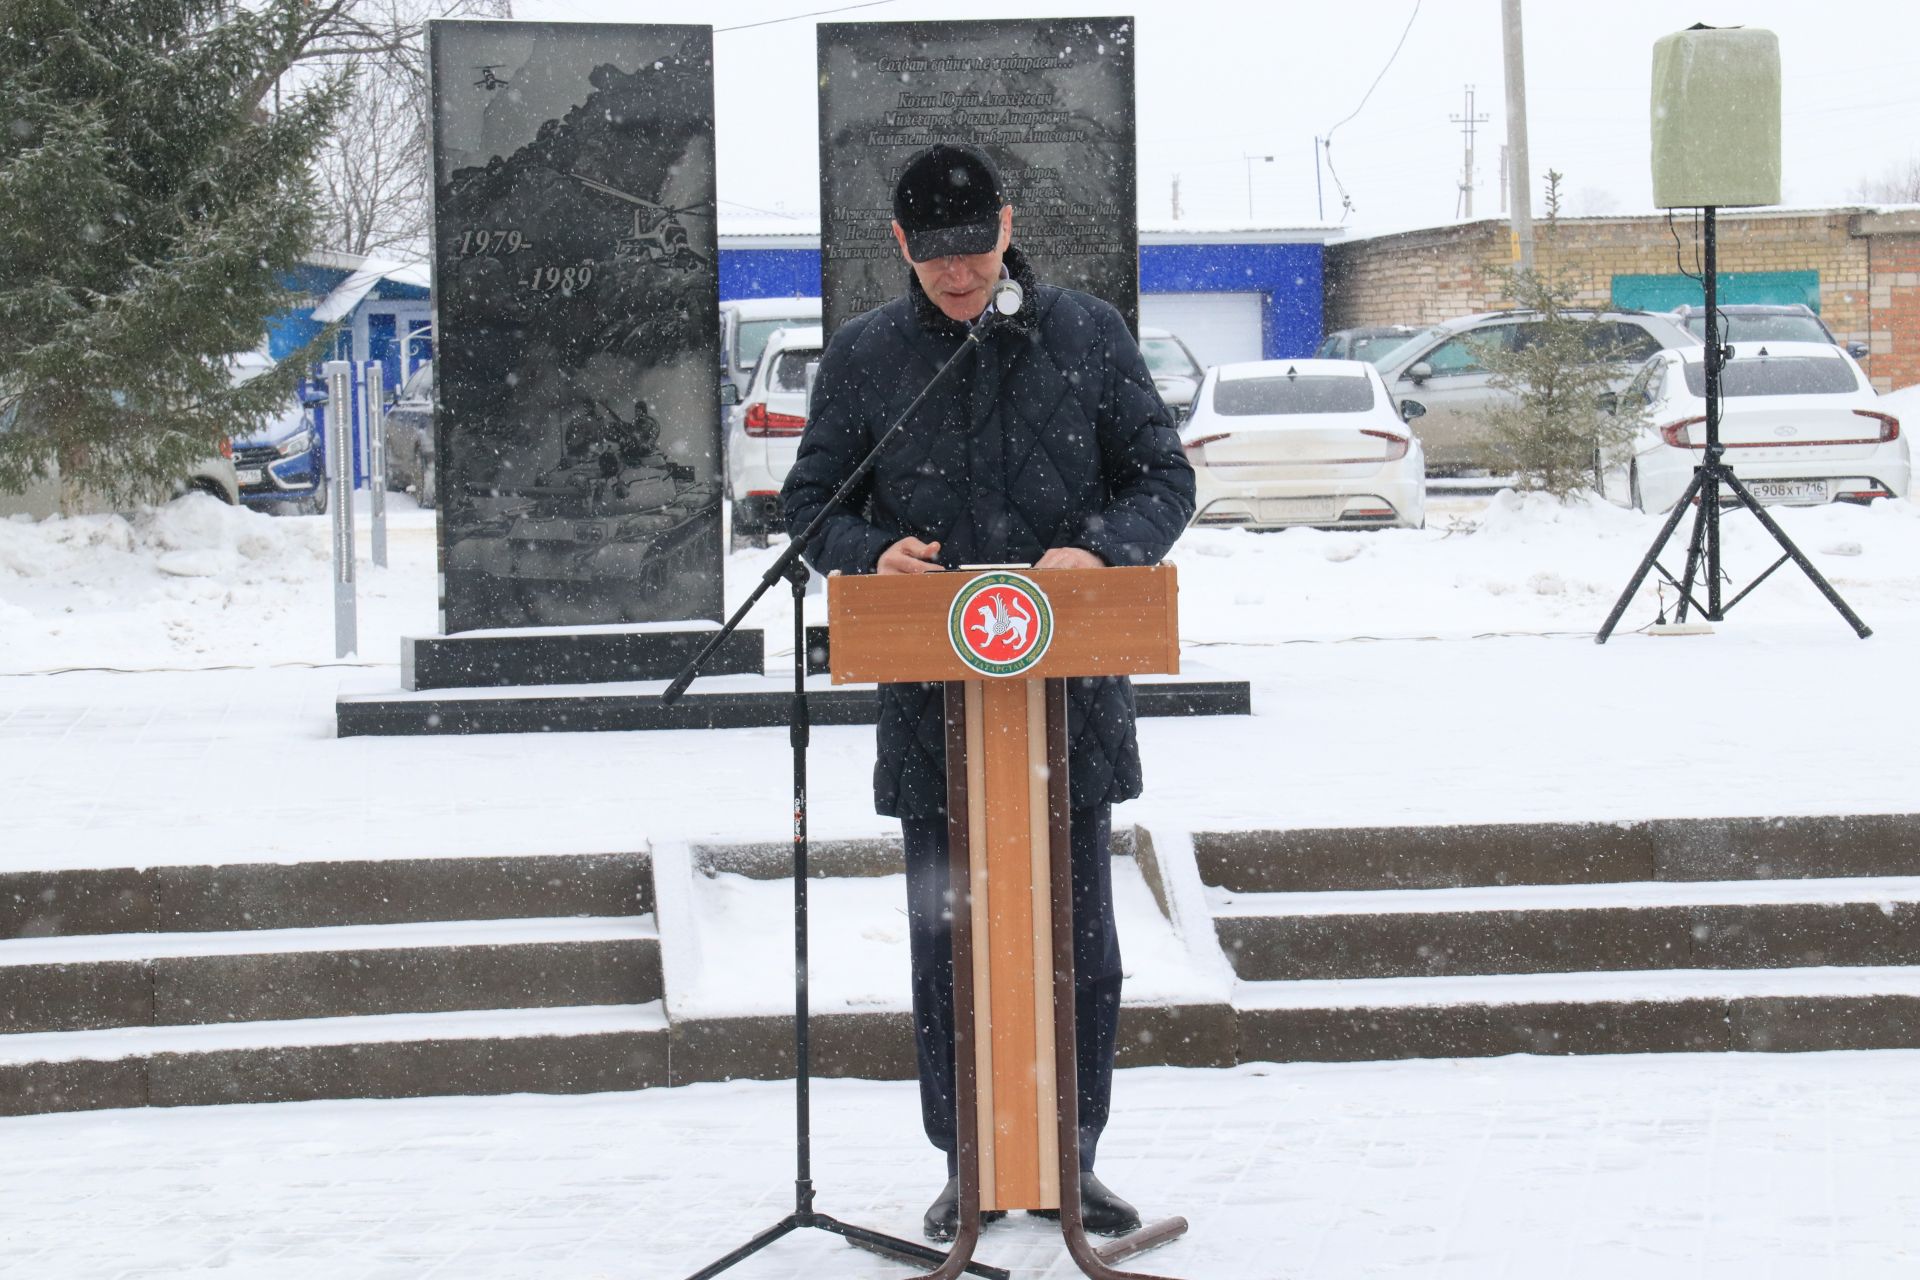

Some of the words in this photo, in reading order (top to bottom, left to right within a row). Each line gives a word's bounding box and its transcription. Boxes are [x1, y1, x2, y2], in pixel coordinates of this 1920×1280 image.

[878, 56, 927, 73] Солдат
[931, 56, 972, 73] войны
[975, 59, 990, 71] не
[897, 93, 937, 108] Козин
[938, 91, 979, 110] Юрий
[981, 91, 1053, 107] Алексеевич
[967, 128, 1021, 146] Альберт
[1023, 124, 1084, 144] Анасович
